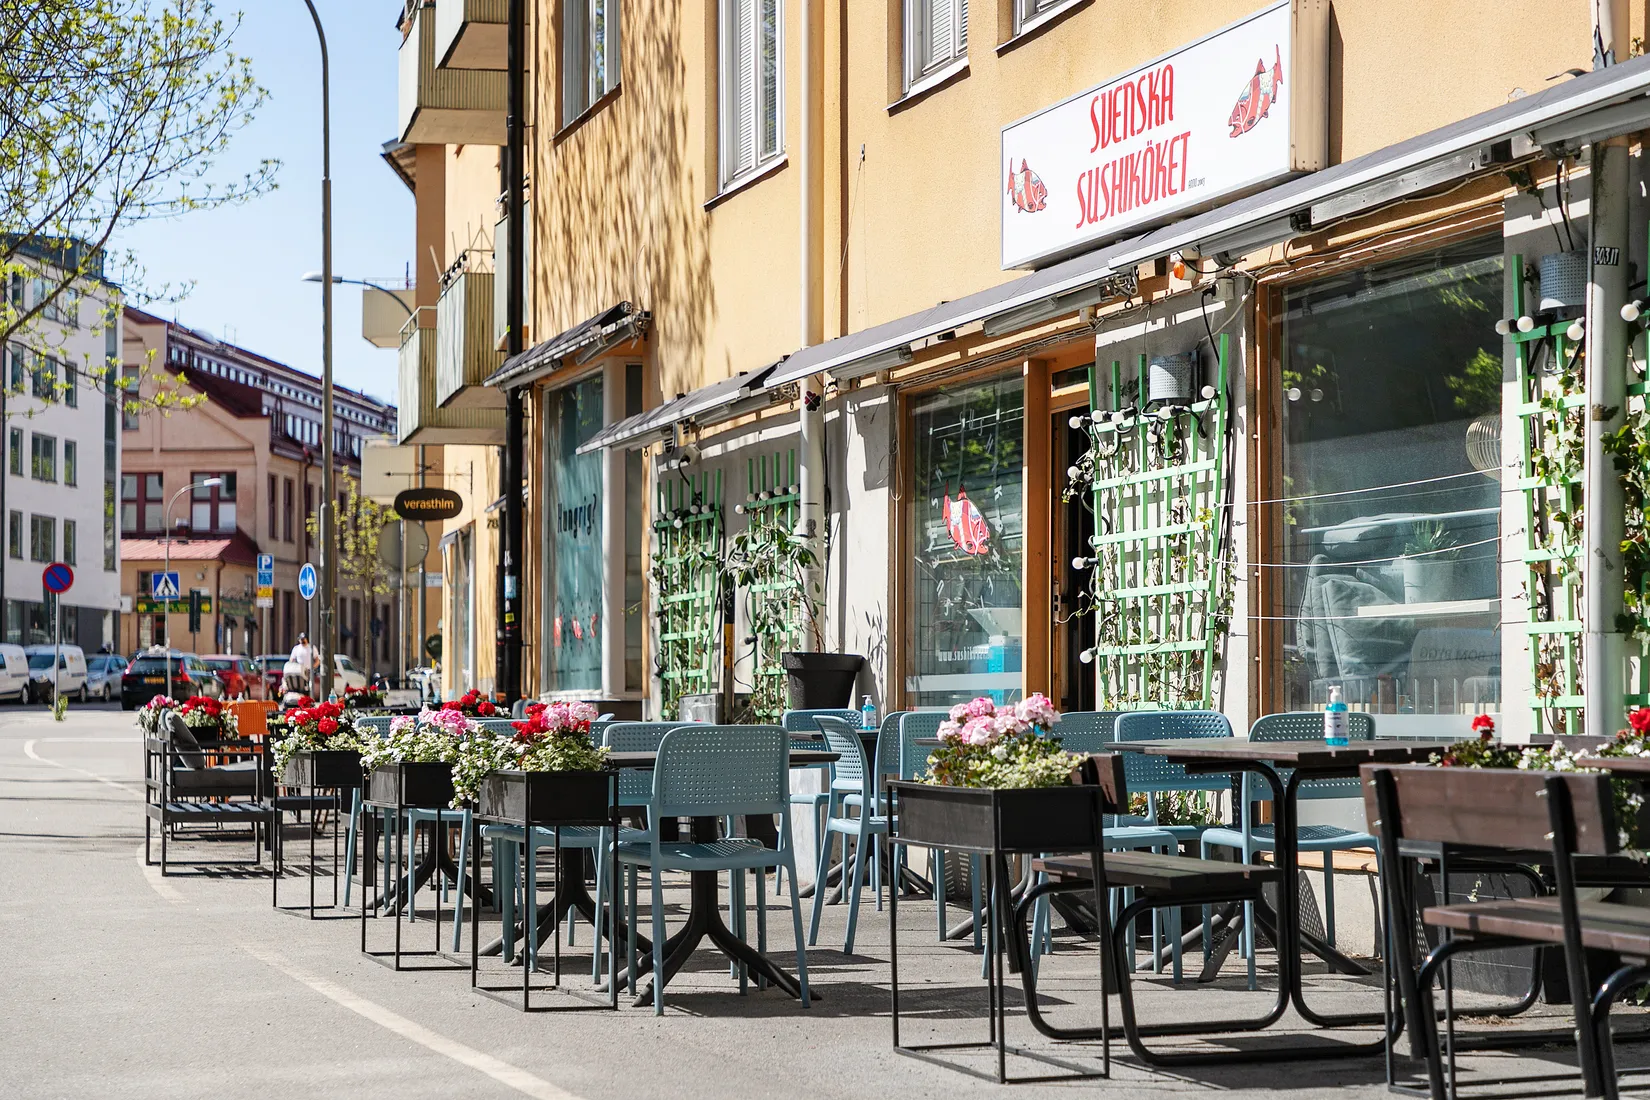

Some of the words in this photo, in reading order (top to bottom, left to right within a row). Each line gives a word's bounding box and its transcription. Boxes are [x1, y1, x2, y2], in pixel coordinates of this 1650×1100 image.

[1090, 64, 1174, 154] SVENSKA
[1076, 131, 1191, 230] SUSHIKÖKET
[404, 498, 455, 510] verasthlm
[557, 493, 597, 539] Hungrig?
[261, 555, 271, 570] P
